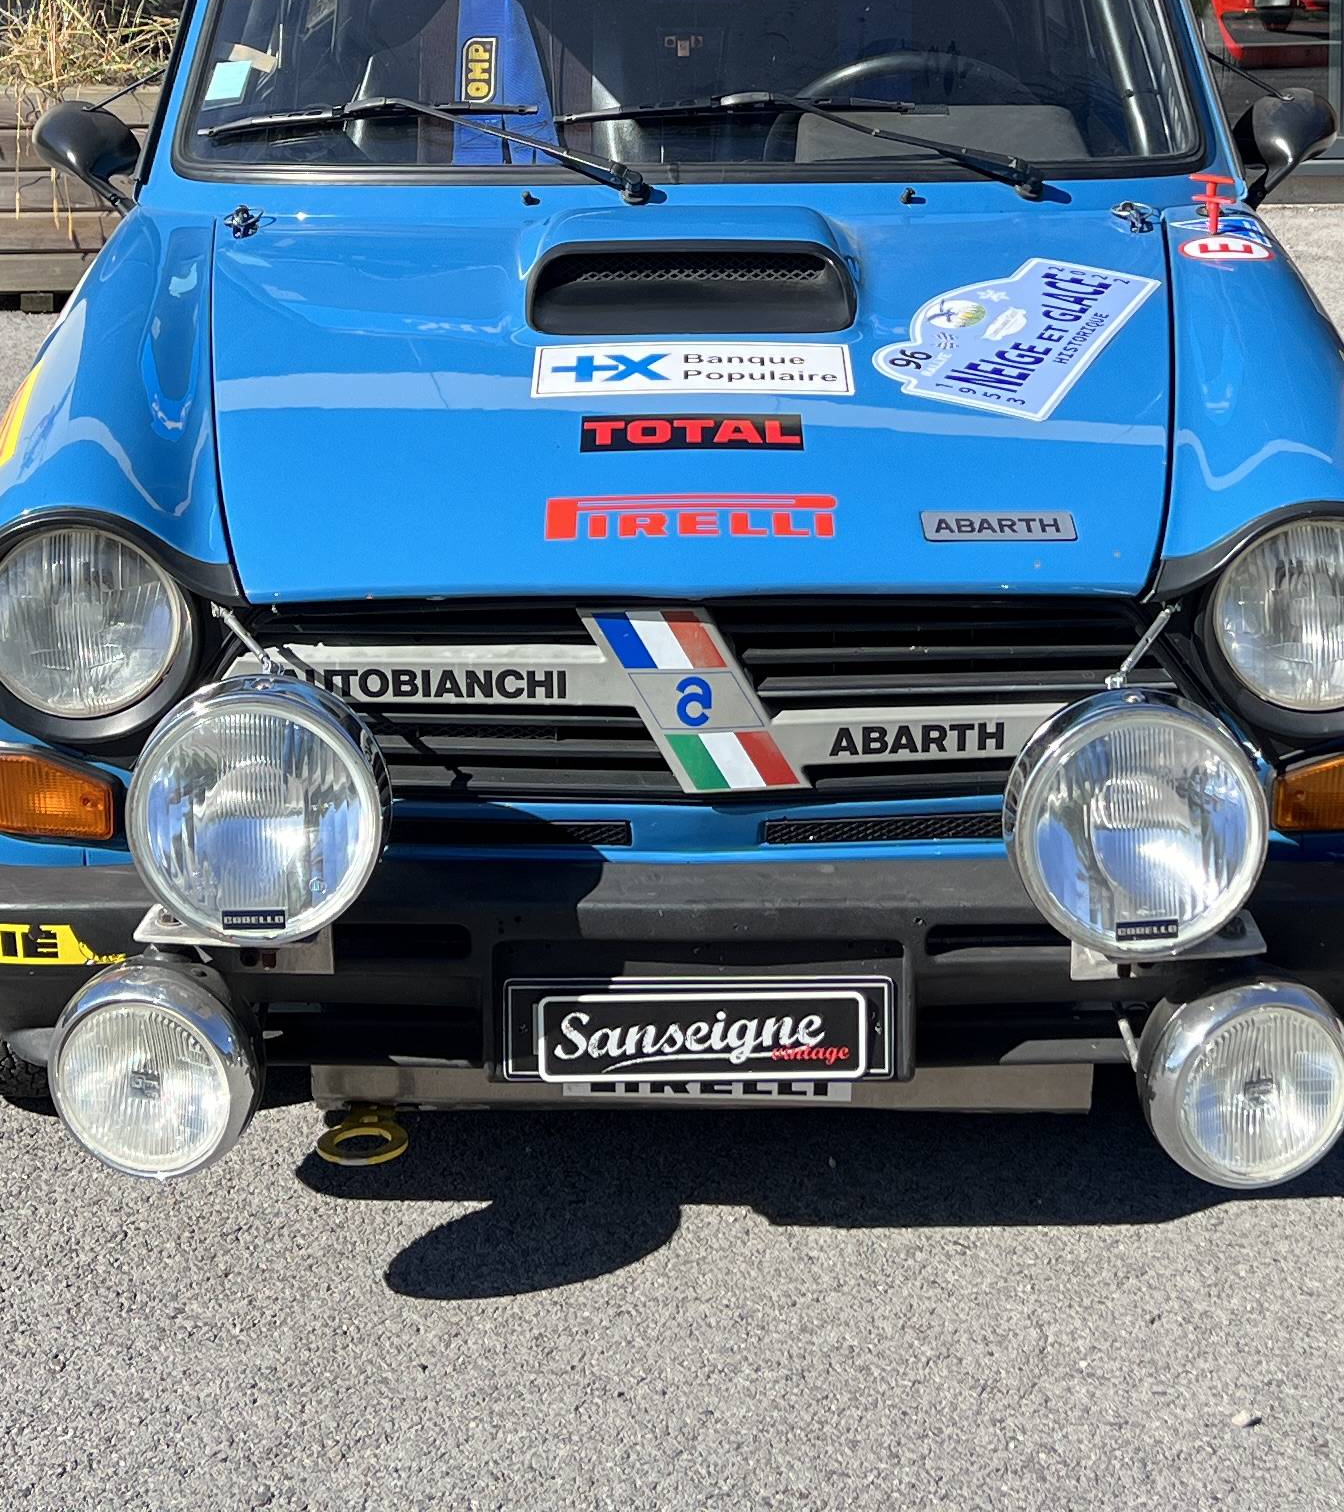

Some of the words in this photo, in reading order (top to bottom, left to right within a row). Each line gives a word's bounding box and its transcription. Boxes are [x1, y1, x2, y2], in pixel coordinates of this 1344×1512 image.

[467, 44, 490, 97] OMP
[1041, 273, 1113, 323] GLACE
[1036, 325, 1070, 342] ET
[1053, 312, 1110, 365] HISTORIQUE
[683, 354, 805, 367] Banque
[889, 349, 933, 370] 96
[944, 342, 1053, 394] NEIGE
[683, 369, 838, 383] Populaire
[583, 419, 801, 446] TOTAL
[544, 493, 837, 540] PIRELLI
[935, 518, 1061, 534] ABARTH
[829, 722, 1005, 756] ABARTH
[554, 1010, 825, 1064] Sanseigne
[771, 1044, 850, 1066] vintage
